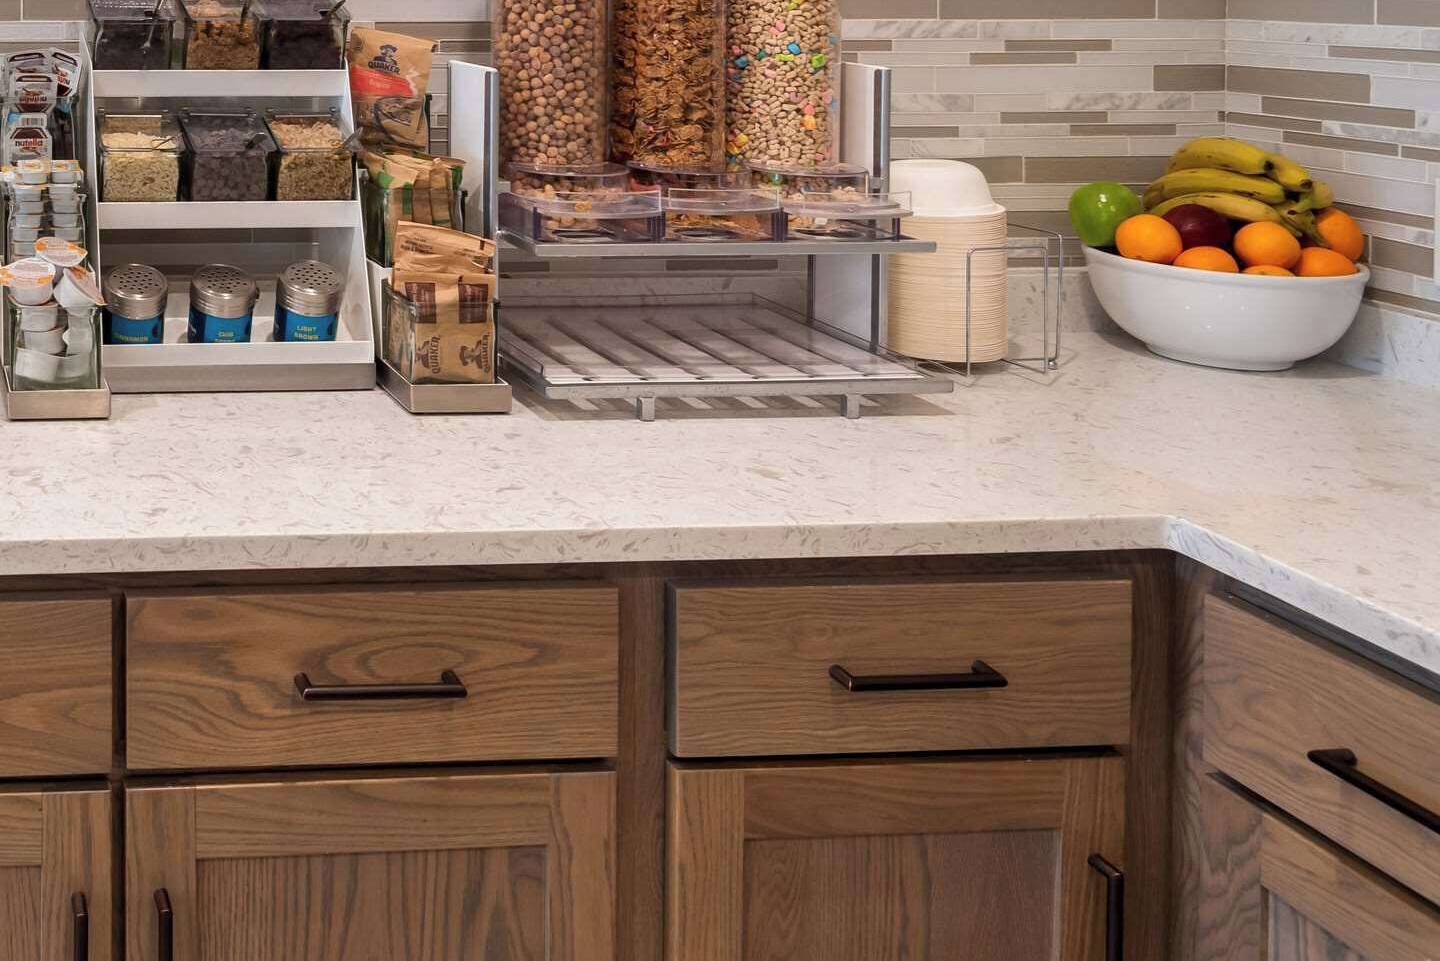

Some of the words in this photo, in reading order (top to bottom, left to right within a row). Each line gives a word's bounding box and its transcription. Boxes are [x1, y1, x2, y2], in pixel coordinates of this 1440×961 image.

[368, 60, 400, 74] QUAKER
[15, 139, 44, 147] nutella
[428, 335, 441, 374] QUAKER
[481, 332, 491, 374] QUAKER
